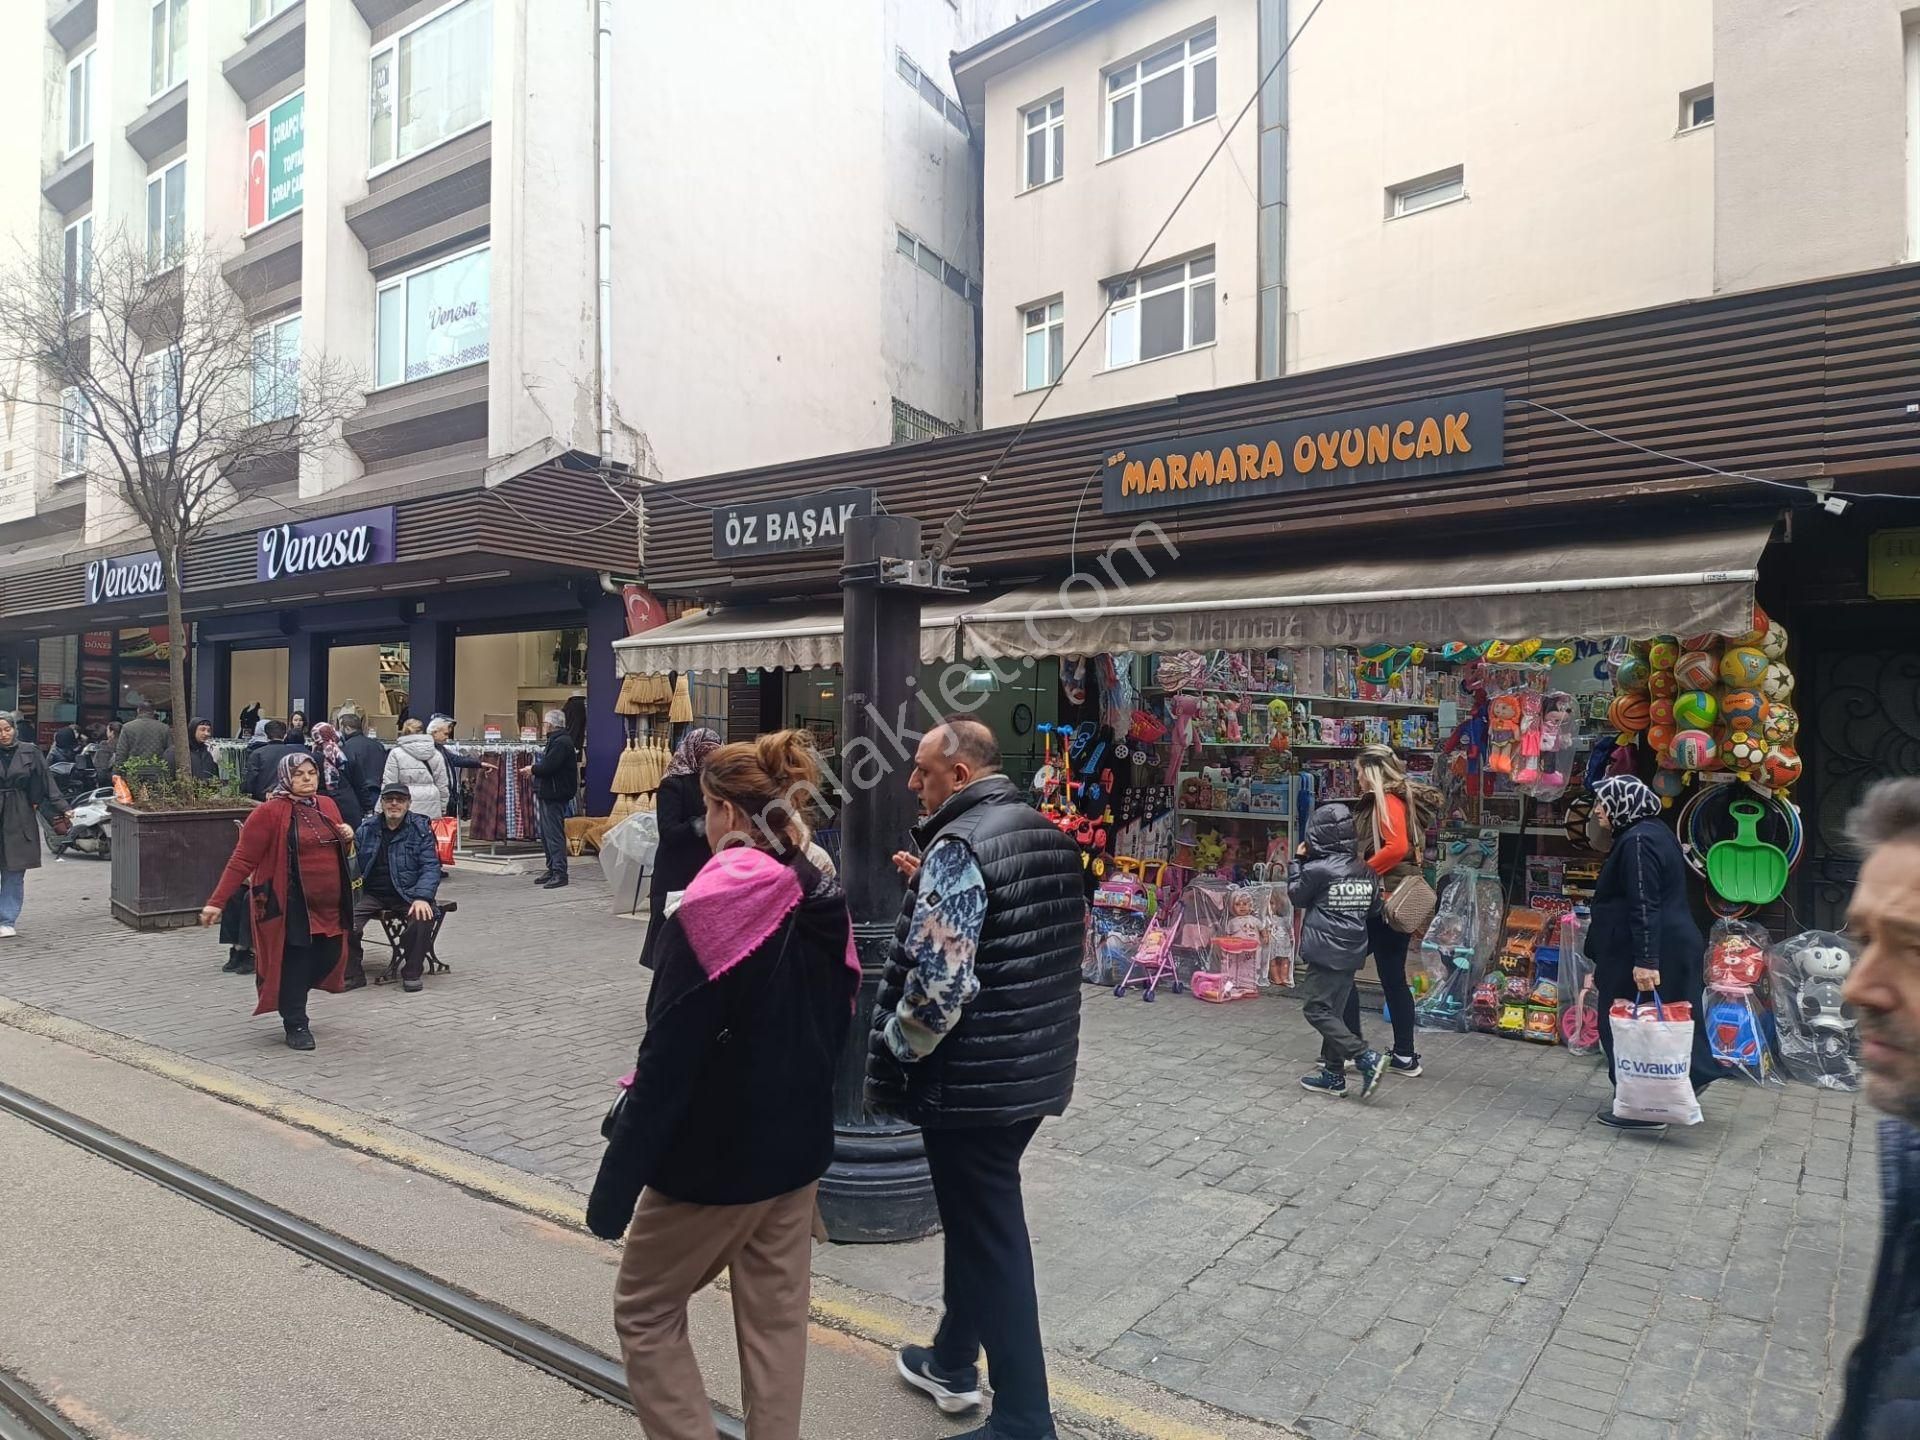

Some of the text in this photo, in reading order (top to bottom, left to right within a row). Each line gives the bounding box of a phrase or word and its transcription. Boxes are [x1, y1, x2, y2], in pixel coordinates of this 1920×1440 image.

[1121, 440, 1283, 497] MARMARA
[1293, 411, 1472, 474] OYUNCAK
[725, 503, 857, 546] ÖZ BAŞAK
[262, 524, 371, 580] Venesa
[88, 559, 165, 604] Venesa
[1129, 615, 1174, 643] ES
[1189, 611, 1305, 642] Marmara
[1328, 882, 1373, 896] STORM
